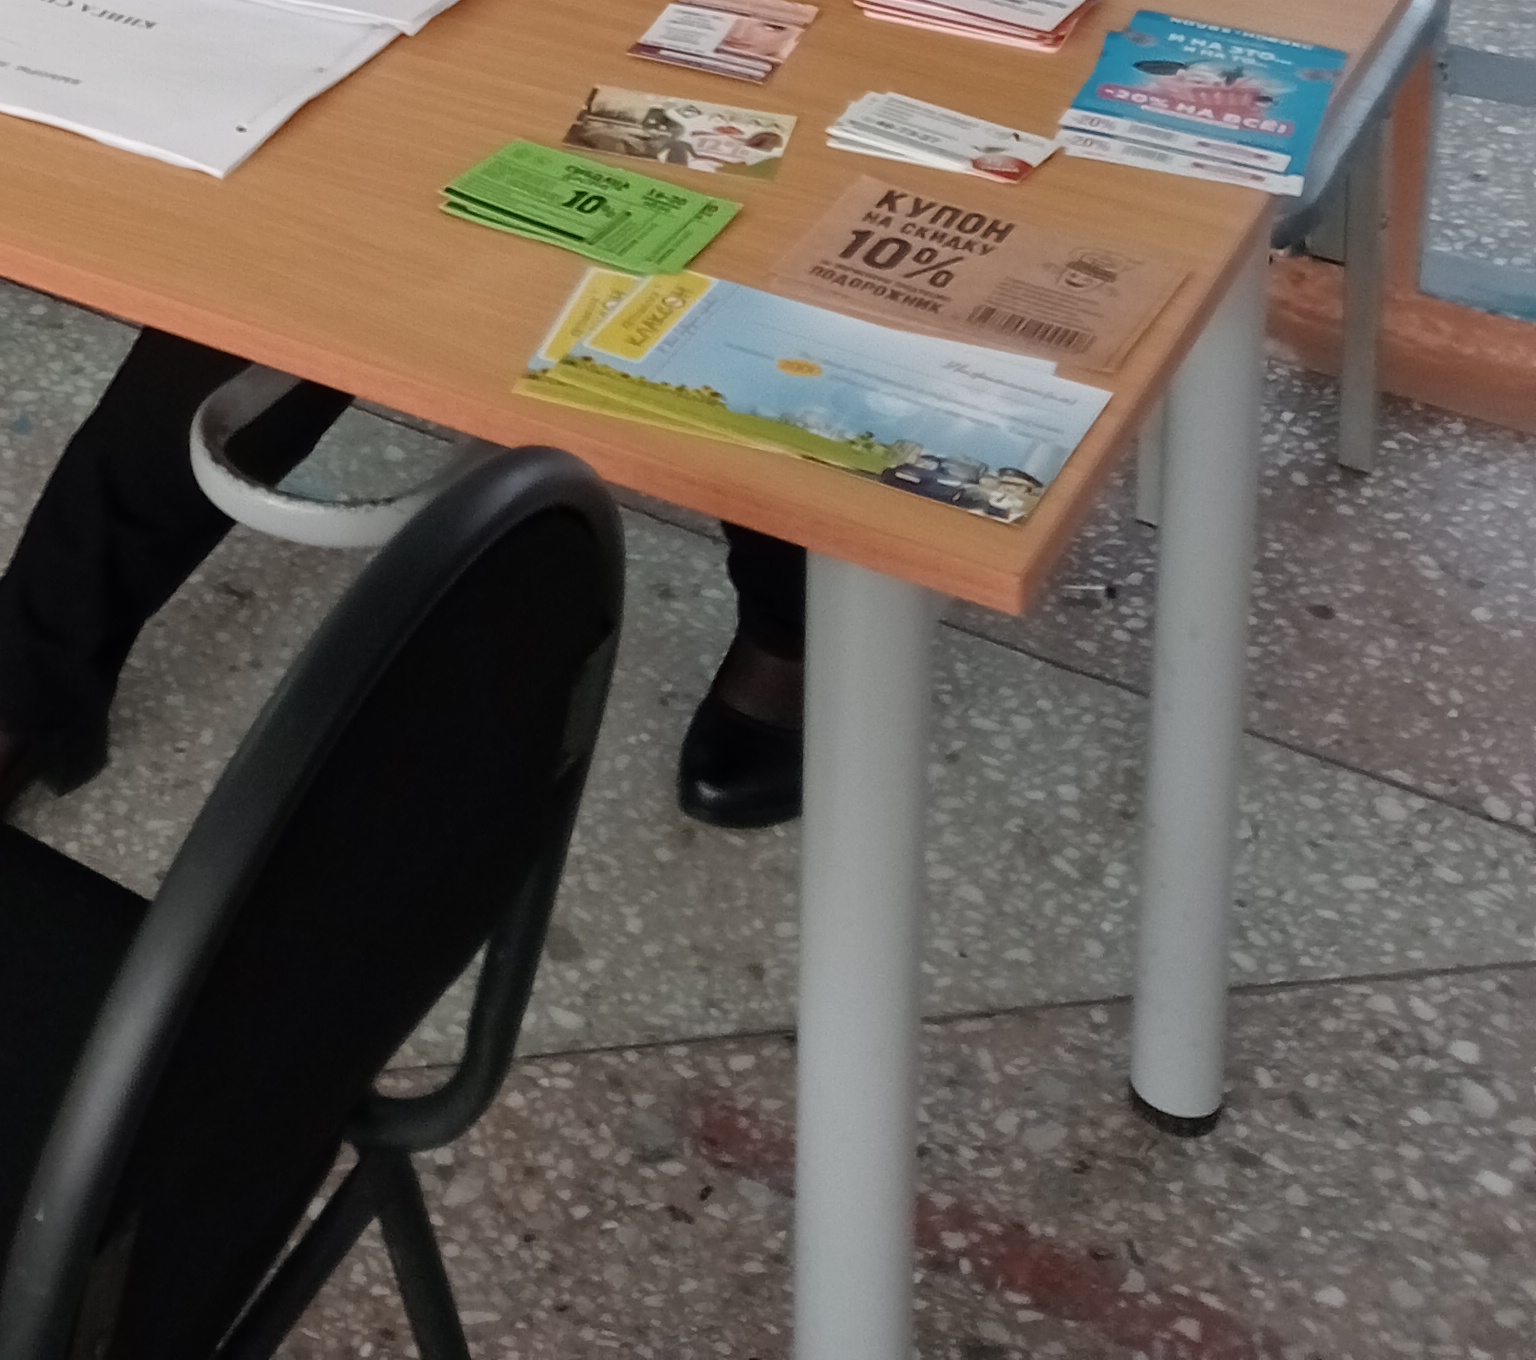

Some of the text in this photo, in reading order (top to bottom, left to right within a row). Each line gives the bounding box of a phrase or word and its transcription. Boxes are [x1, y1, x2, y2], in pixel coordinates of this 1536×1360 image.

[1176, 103, 1214, 119] НА
[862, 210, 1002, 258] НА СКИДКУ
[875, 188, 1019, 245] КУПОН
[838, 229, 965, 290] 10%
[808, 265, 944, 313] ПОДОРОЖНИК
